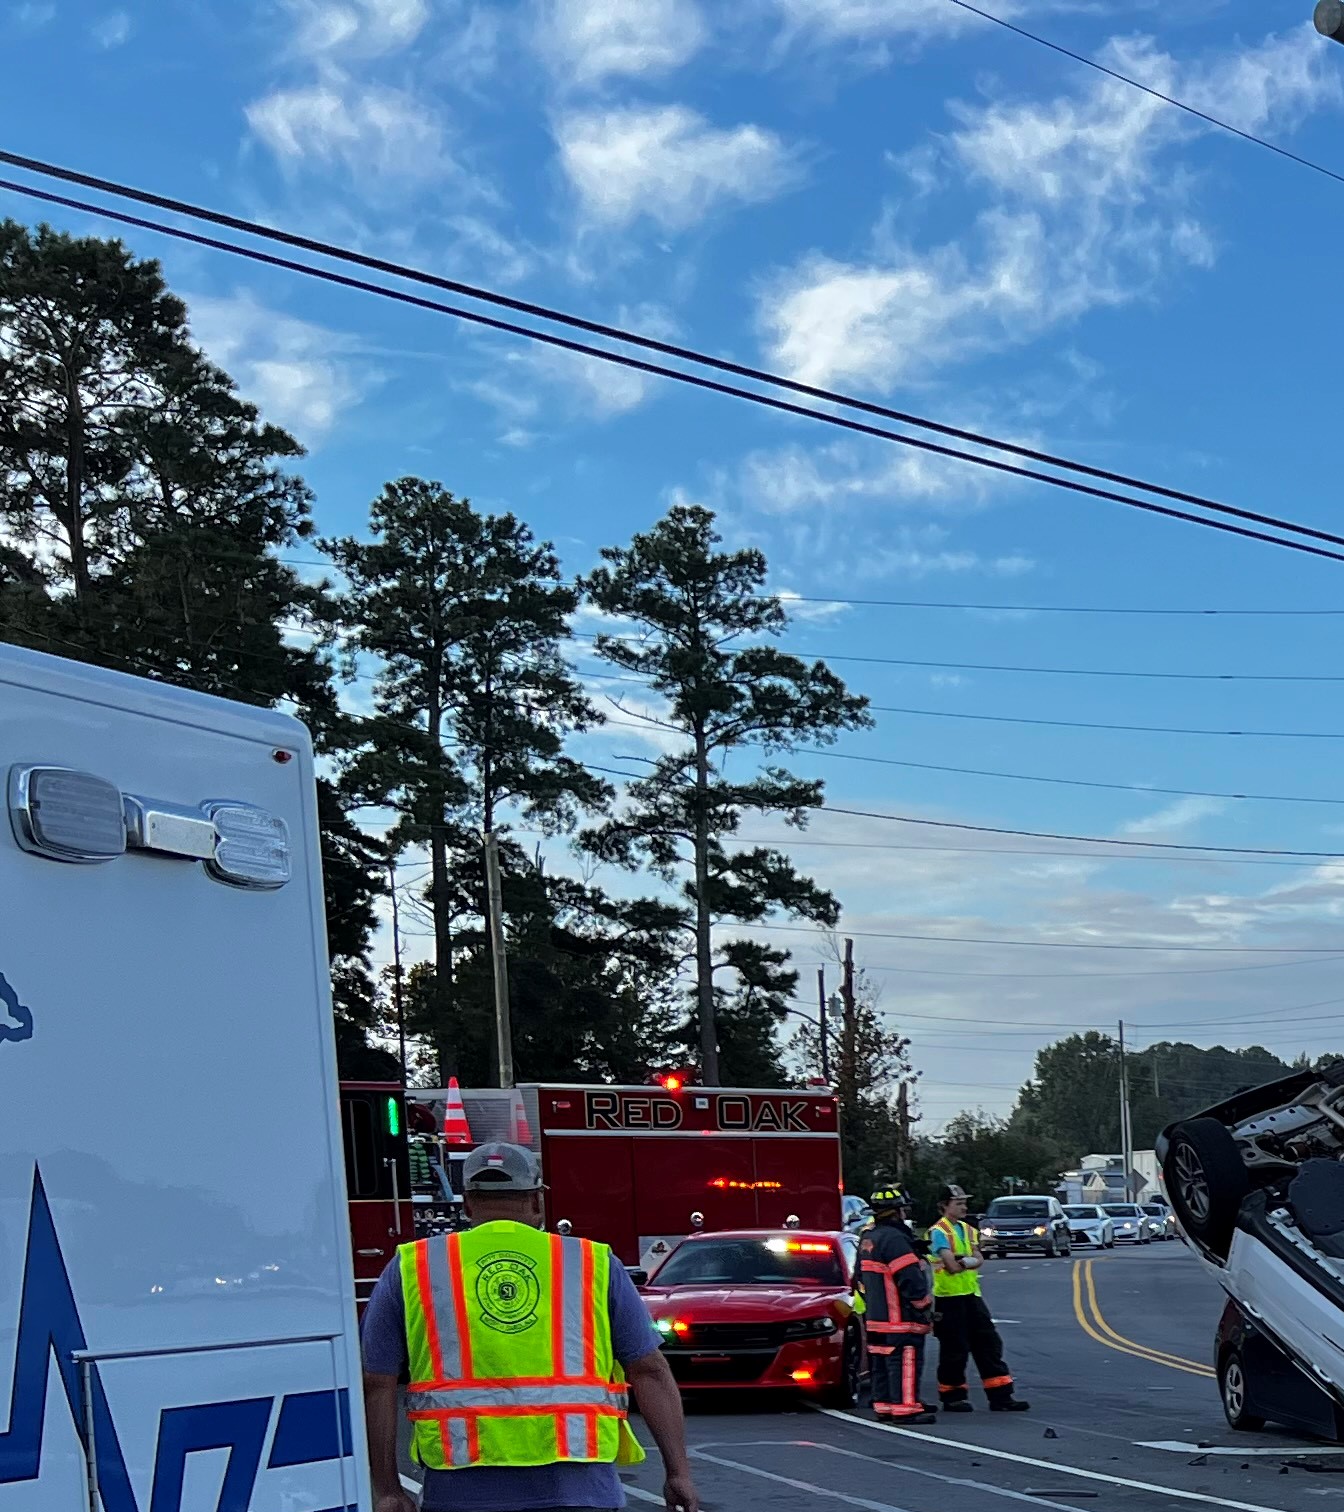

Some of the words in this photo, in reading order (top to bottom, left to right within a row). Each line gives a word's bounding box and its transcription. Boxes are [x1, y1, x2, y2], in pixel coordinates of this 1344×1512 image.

[585, 1090, 683, 1130] RED
[716, 1094, 811, 1132] OAK
[482, 1263, 504, 1282] RED
[509, 1263, 535, 1282] OAK
